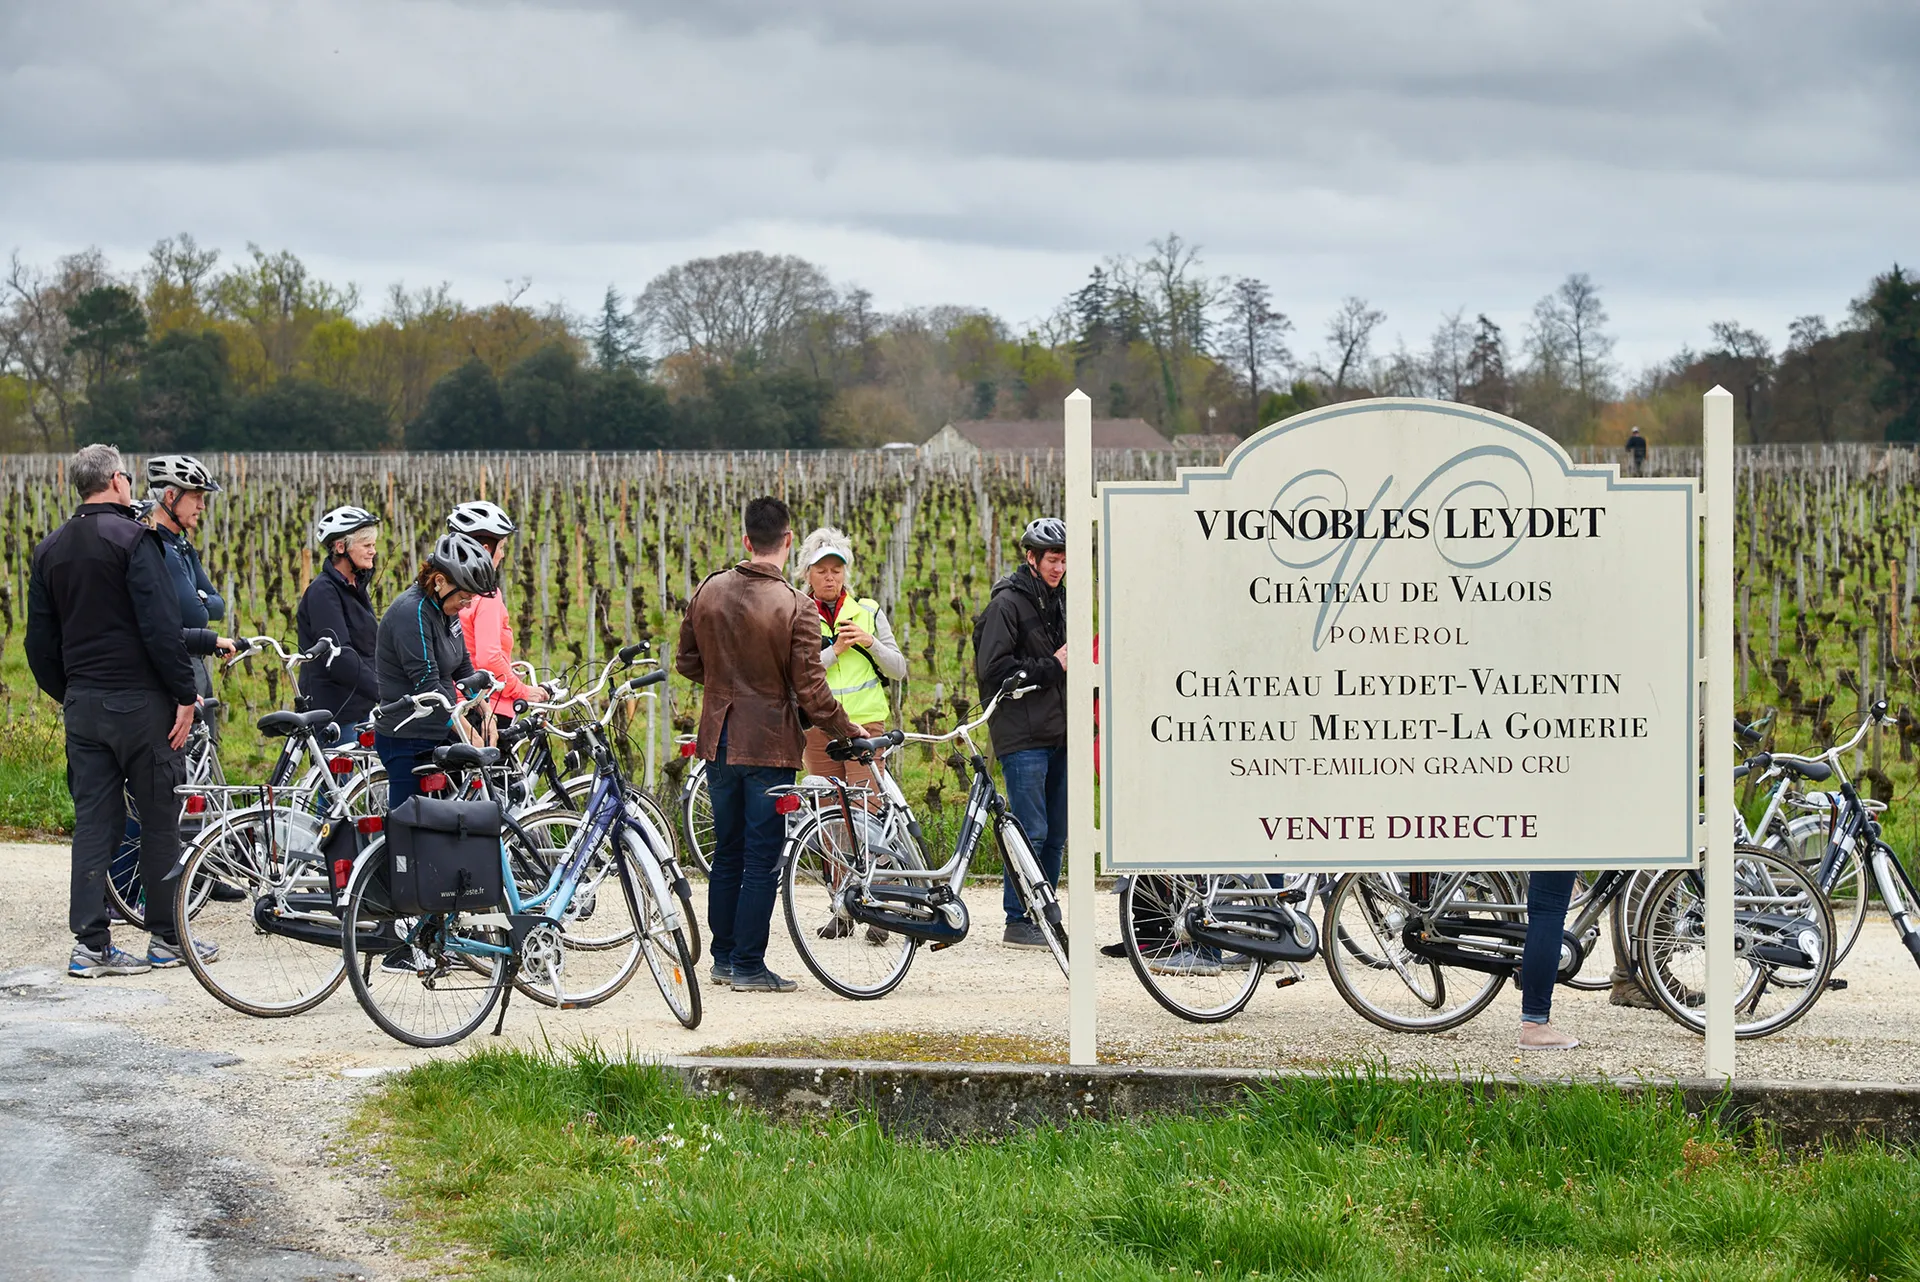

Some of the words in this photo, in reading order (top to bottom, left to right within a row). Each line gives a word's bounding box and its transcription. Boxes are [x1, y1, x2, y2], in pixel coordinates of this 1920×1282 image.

[1194, 507, 1431, 541] VIGNOBLES
[1444, 507, 1607, 539] LEYDET
[1249, 576, 1391, 604] CHÂTEAU
[1400, 582, 1439, 603] DE
[1447, 575, 1553, 602] VALOIS
[1329, 625, 1470, 646] POMEROL
[1175, 669, 1322, 699] CHÂTEAU
[1334, 668, 1622, 697] LEYDET-VALENTIN
[1150, 714, 1297, 743] CHÂTEAU
[1309, 713, 1492, 742] MEYLET-LA
[1504, 712, 1649, 740] GOMERIE
[1229, 756, 1416, 778] SAINT-EMILION
[1423, 756, 1514, 776] GRAND
[1521, 755, 1571, 775] CRU
[1258, 816, 1376, 841] VENTE
[1386, 814, 1539, 840] DIRECTE
[571, 826, 603, 885] GITANE
[1822, 852, 1845, 895] azelle
[440, 886, 485, 898] www.oste.fr
[1589, 869, 1625, 913] Gazel
